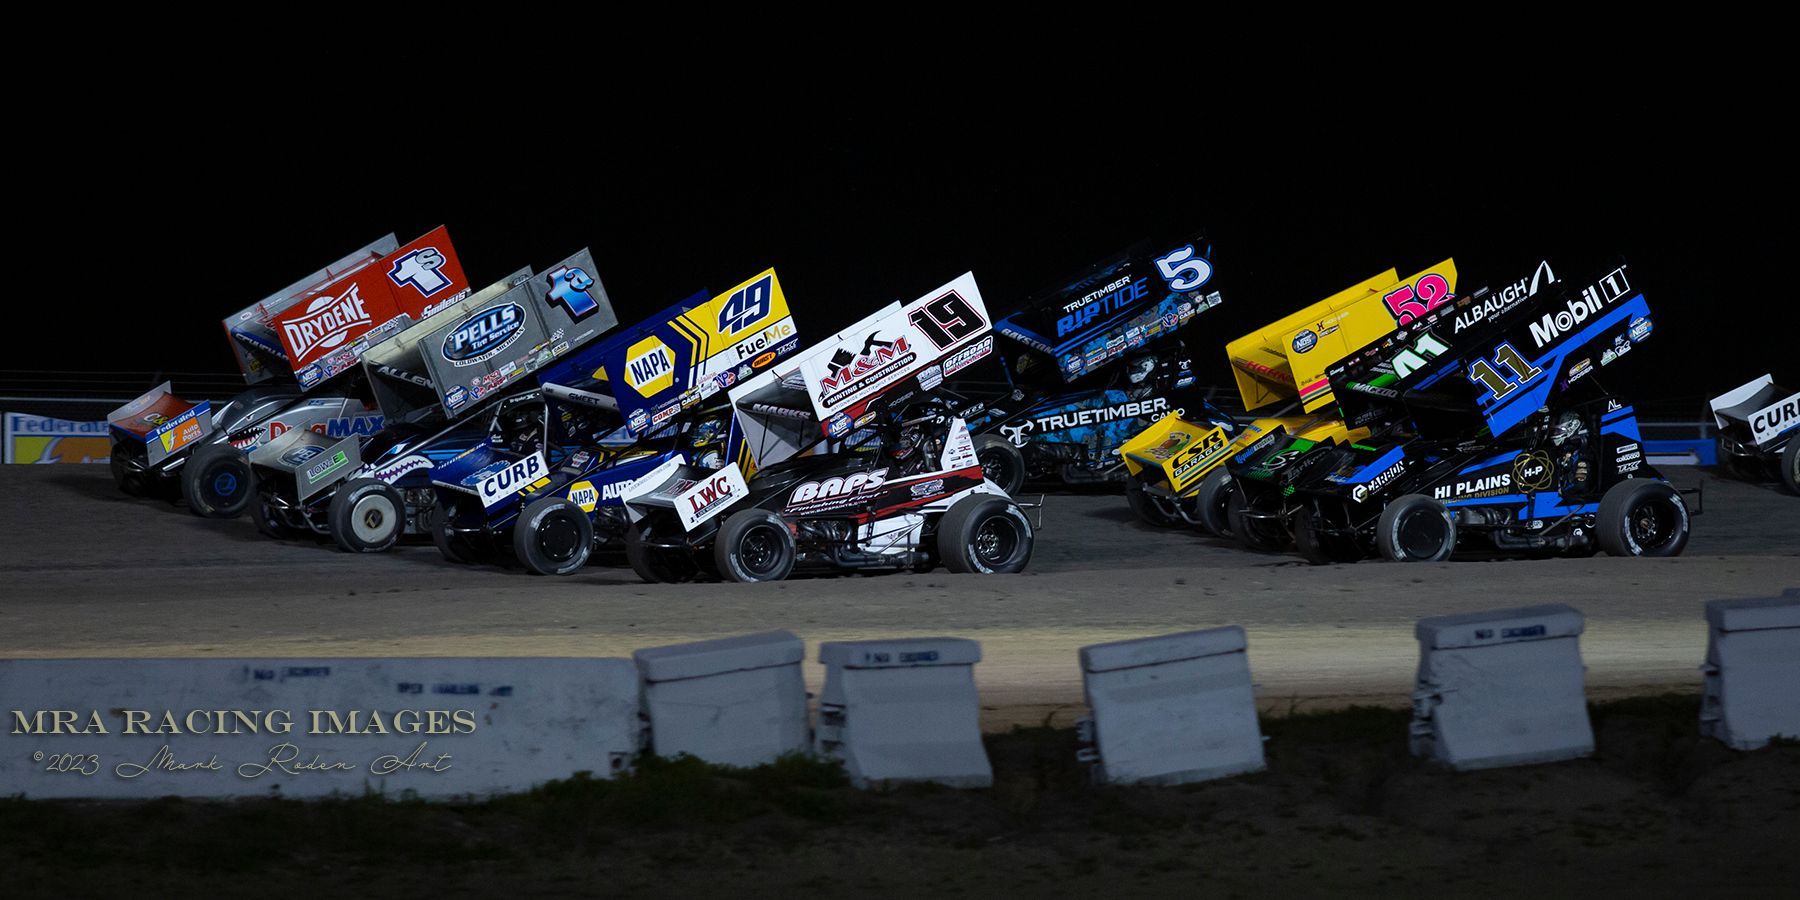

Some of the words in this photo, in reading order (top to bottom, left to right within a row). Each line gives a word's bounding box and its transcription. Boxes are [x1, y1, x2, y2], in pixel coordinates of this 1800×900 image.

[1153, 243, 1214, 293] 5
[718, 273, 773, 336] 49
[1056, 276, 1149, 338] RIPTIDE
[1063, 274, 1131, 313] TRUETIMBER
[1383, 272, 1457, 327] 52
[1454, 279, 1527, 334] ALBAUGH
[283, 286, 371, 358] DRYDENE
[454, 304, 517, 351] PELLS
[907, 289, 987, 352] 19
[1529, 284, 1604, 348] Mobil
[471, 337, 488, 350] Tire
[488, 321, 520, 343] Service
[377, 365, 434, 390] ALLEN
[630, 349, 671, 385] NAPA
[819, 334, 908, 397] M&M
[826, 383, 858, 406] PAINTING
[865, 354, 914, 384] CONSTRUCTION
[1468, 340, 1543, 401] 11
[568, 393, 601, 405] SWEET
[752, 402, 811, 420] MARKS
[1036, 397, 1168, 432] TRUETIMBER
[1151, 407, 1186, 423] CAO
[156, 410, 196, 436] Federated
[183, 424, 199, 435] Auto
[183, 430, 202, 442] Parts
[269, 415, 385, 440] DaMAX
[1172, 431, 1222, 468] CSR
[1174, 440, 1224, 476] GARAGE
[483, 455, 541, 497] CURB
[787, 467, 889, 509] BAPS
[1434, 485, 1451, 499] HI
[1456, 473, 1511, 496] PLAINS
[1524, 465, 1543, 478] H-P
[571, 489, 595, 505] NAPA
[688, 475, 731, 514] LWC
